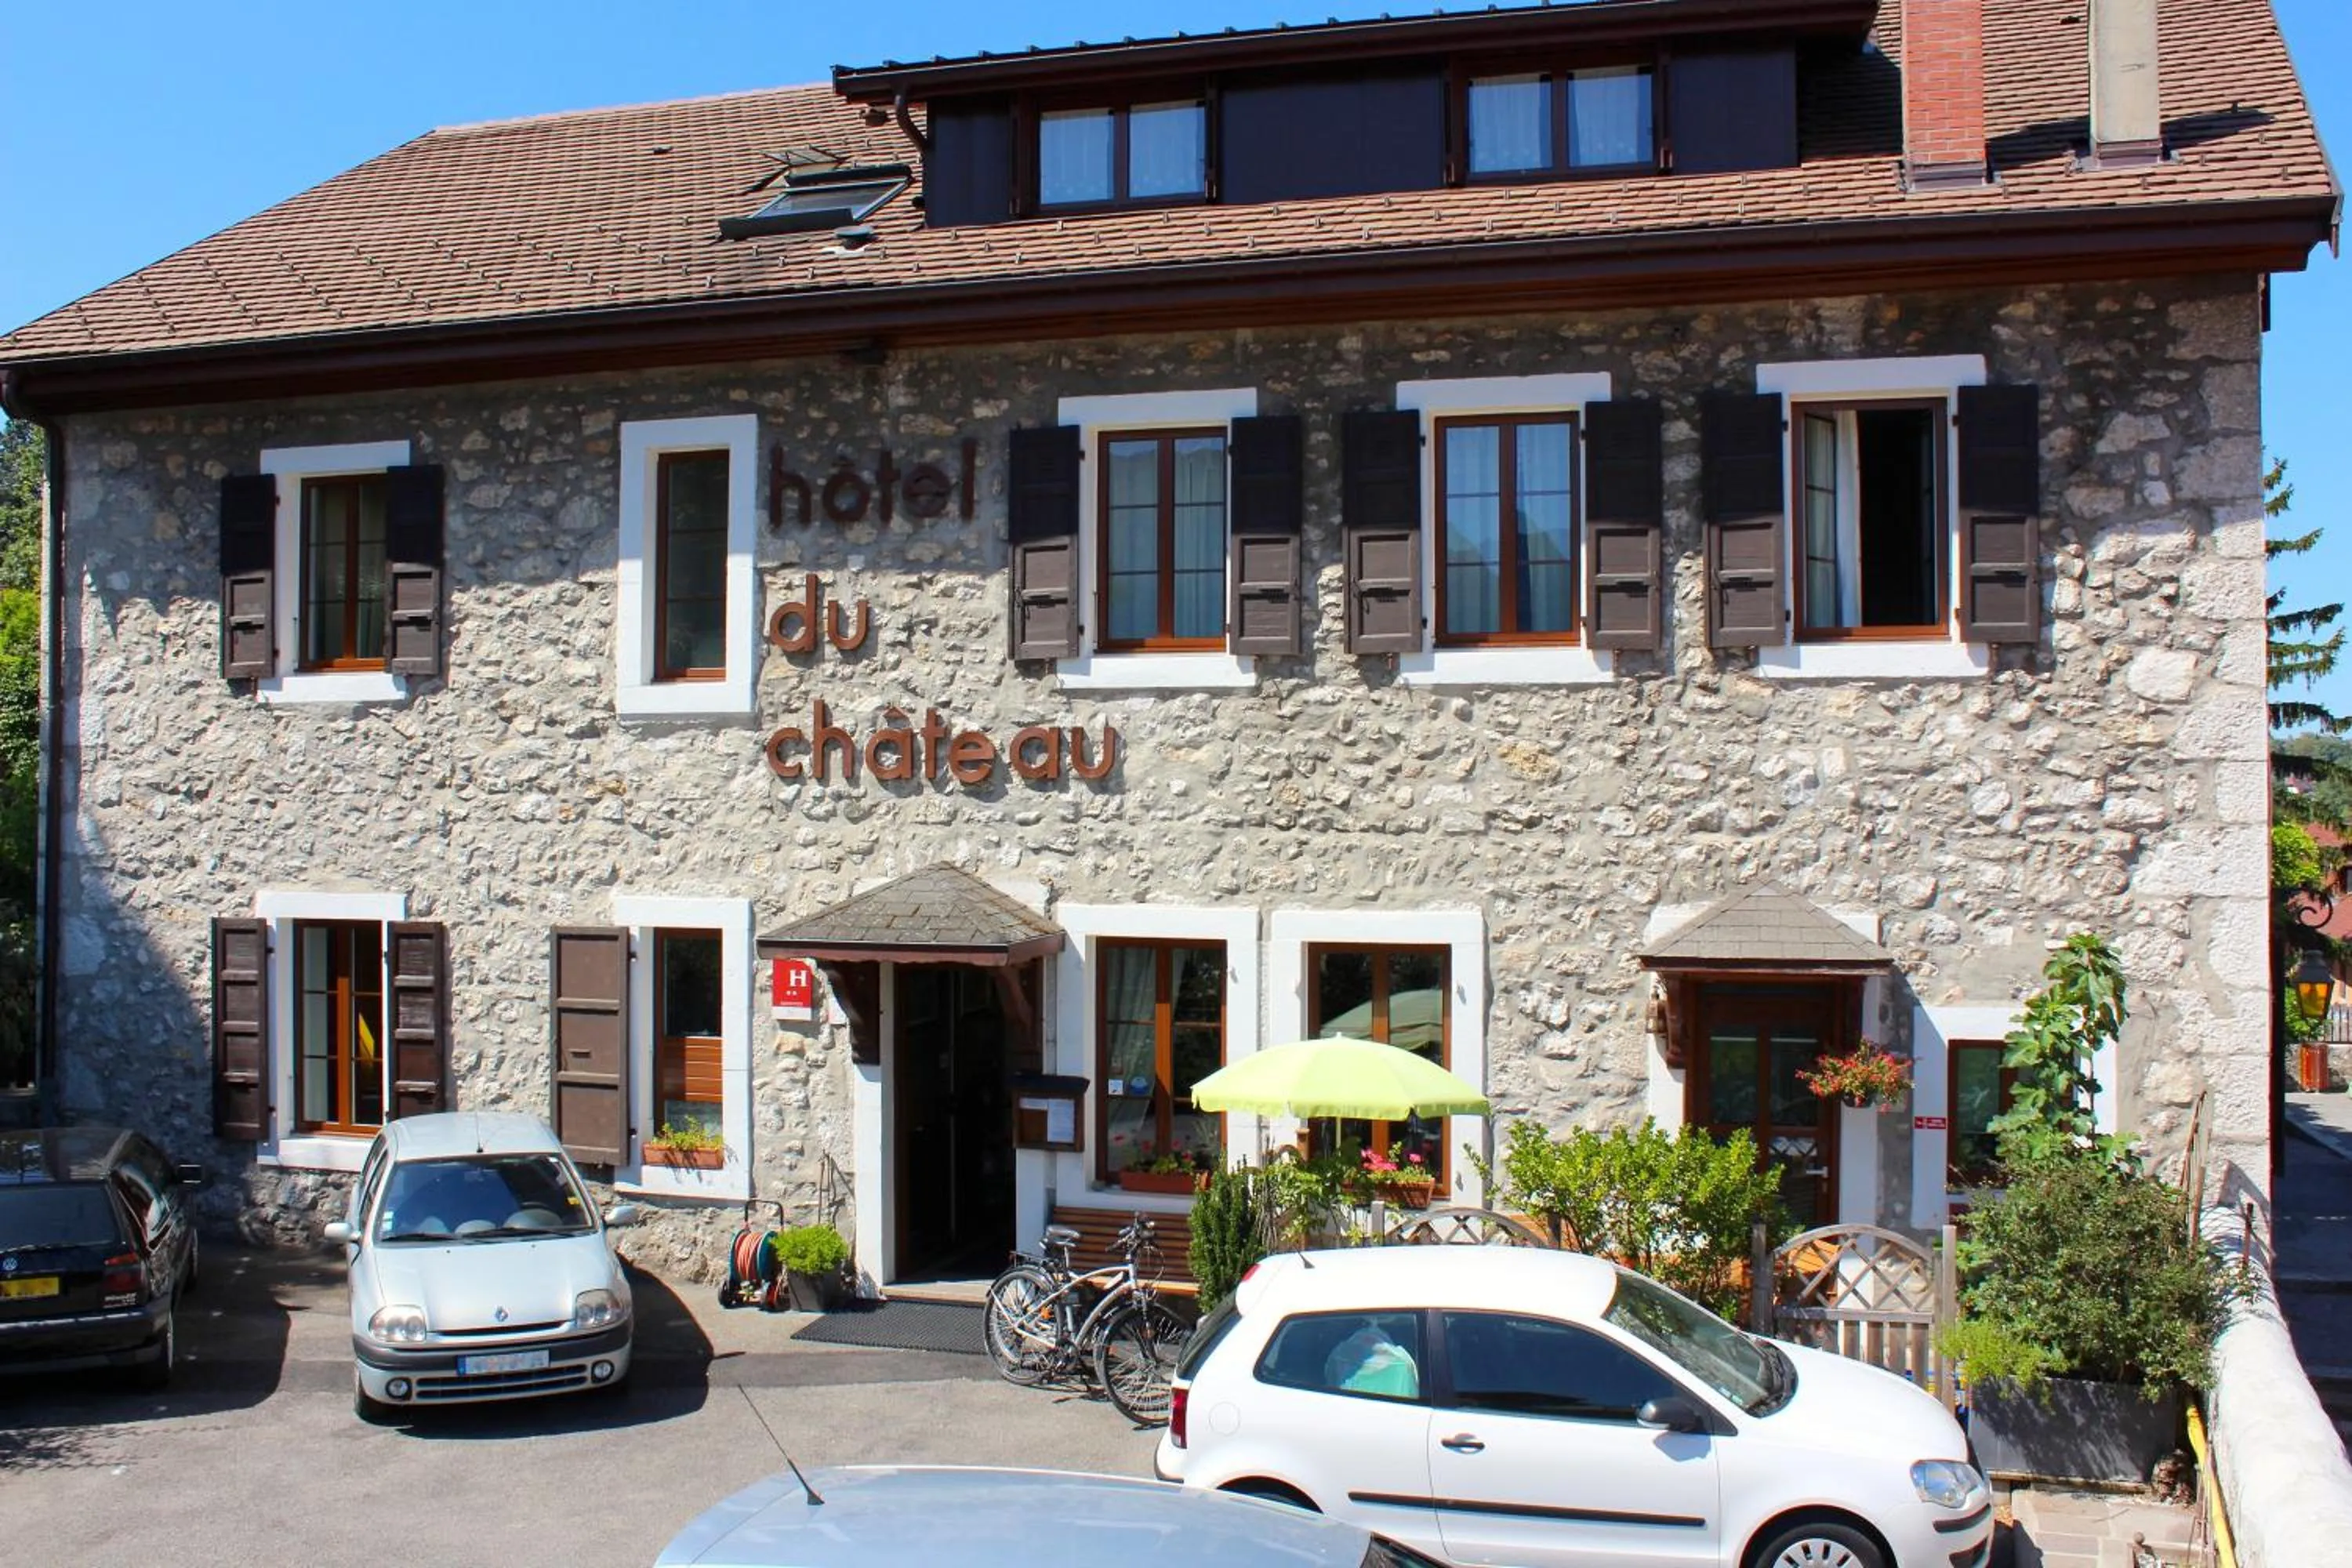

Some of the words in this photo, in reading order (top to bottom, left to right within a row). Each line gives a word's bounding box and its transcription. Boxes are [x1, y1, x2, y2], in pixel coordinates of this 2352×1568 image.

[770, 438, 977, 526] hôtel
[770, 574, 867, 652] du
[765, 699, 1115, 782] château
[789, 969, 808, 987] H
